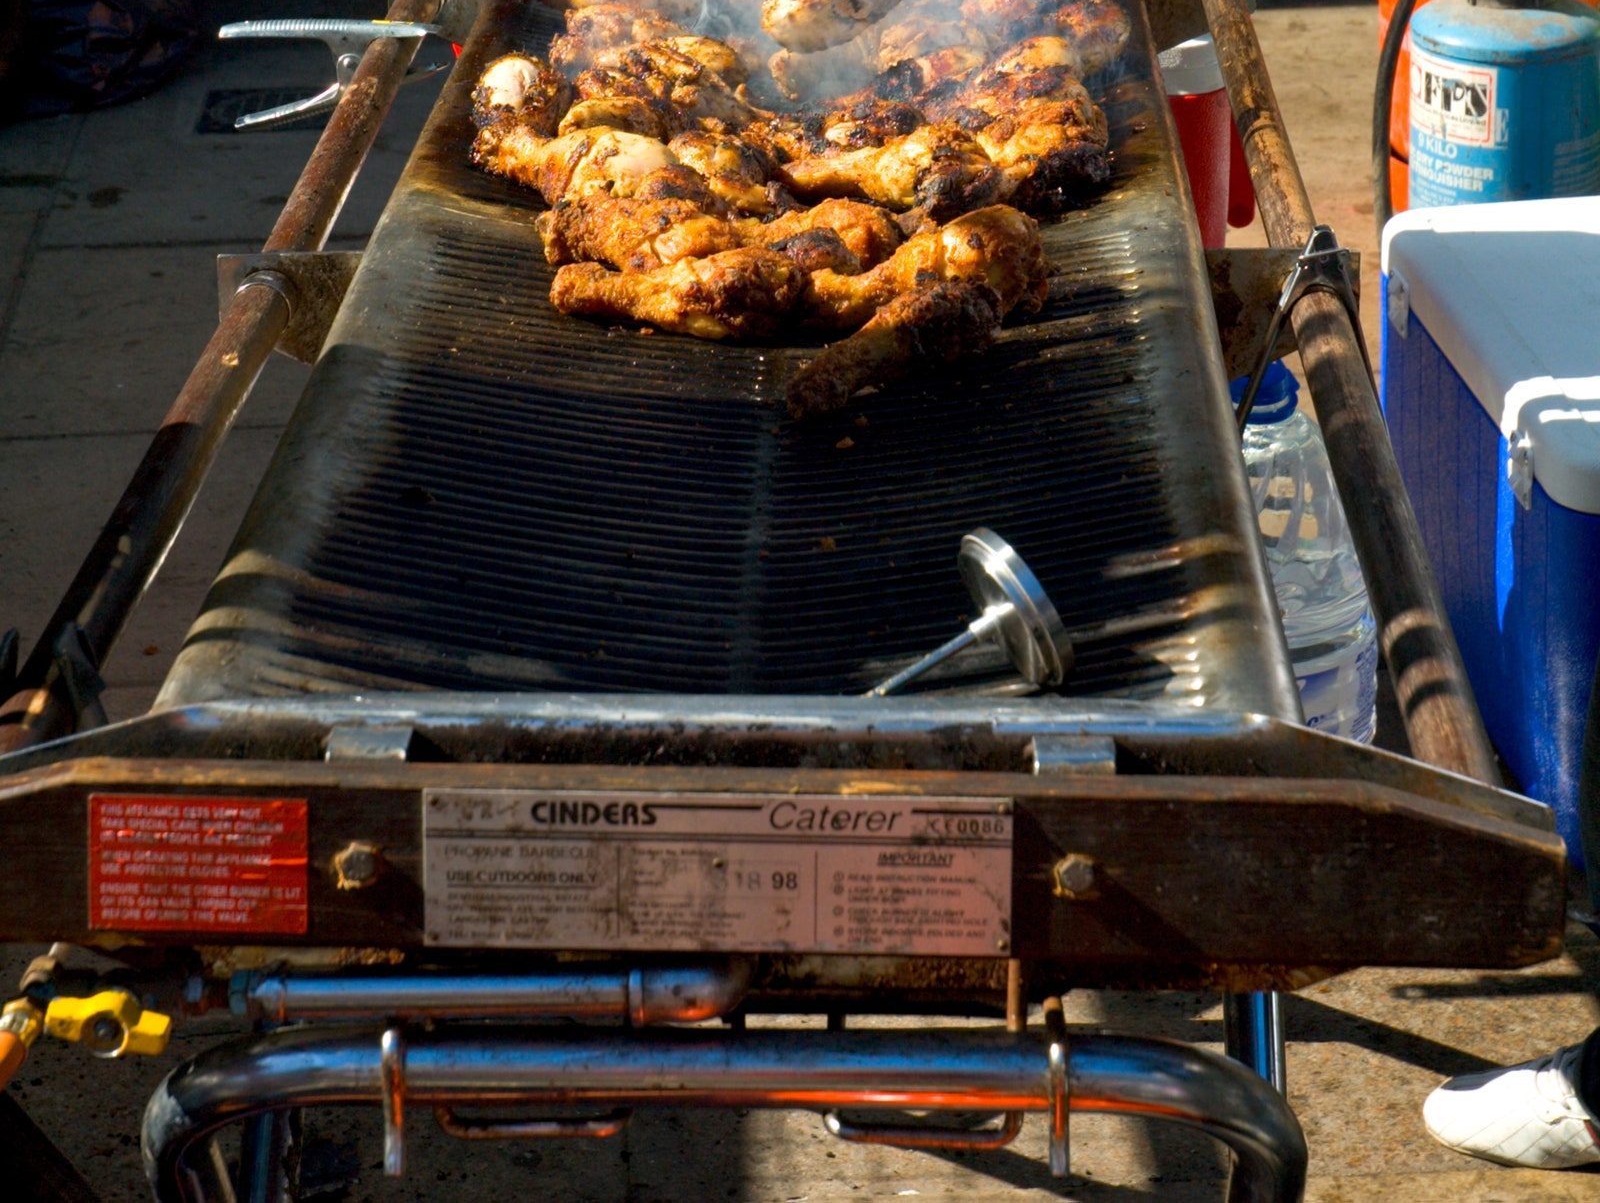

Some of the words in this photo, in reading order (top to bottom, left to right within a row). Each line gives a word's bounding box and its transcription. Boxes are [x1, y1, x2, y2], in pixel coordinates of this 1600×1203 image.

[1426, 134, 1458, 160] KILO
[1435, 158, 1494, 182] POWDER
[125, 803, 181, 818] APPLIANCE
[531, 800, 657, 827] CINDERS
[769, 800, 902, 832] Caterer
[127, 817, 169, 831] SPECIAL
[444, 844, 512, 859] PROPANE
[519, 845, 599, 860] BARBECUE
[878, 850, 955, 866] IMPORTANT
[446, 869, 475, 882] USE
[476, 870, 557, 884] OUTDOORS
[559, 871, 599, 884] ONLY
[99, 881, 140, 895] ENSURE
